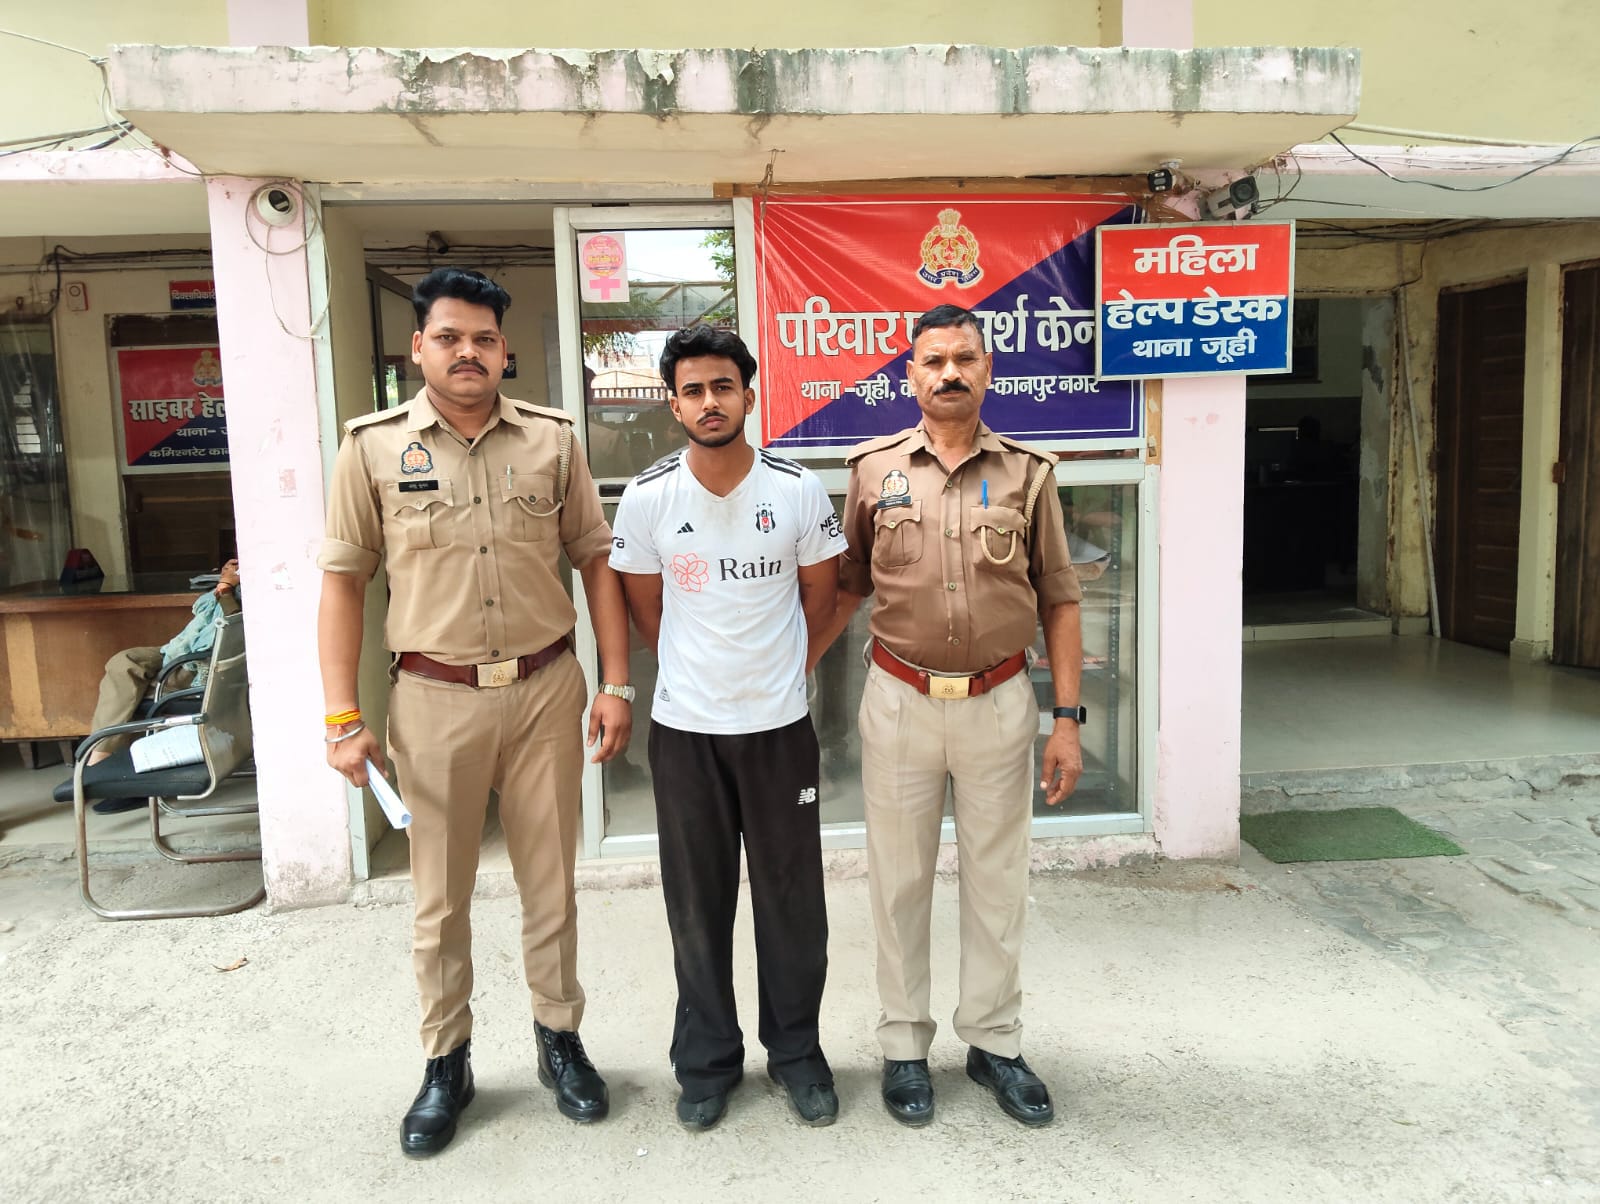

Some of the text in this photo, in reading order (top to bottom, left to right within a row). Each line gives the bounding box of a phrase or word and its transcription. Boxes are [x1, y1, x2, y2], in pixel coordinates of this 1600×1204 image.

[1133, 235, 1259, 275] महिला
[776, 296, 900, 356] परिवार
[1105, 286, 1287, 329] हेल्प डेस्क
[1132, 326, 1257, 364] थाना जूही
[801, 379, 841, 400] थाना
[1058, 375, 1100, 394] नगर
[128, 398, 195, 423] साइबर
[719, 556, 782, 581] Rain
